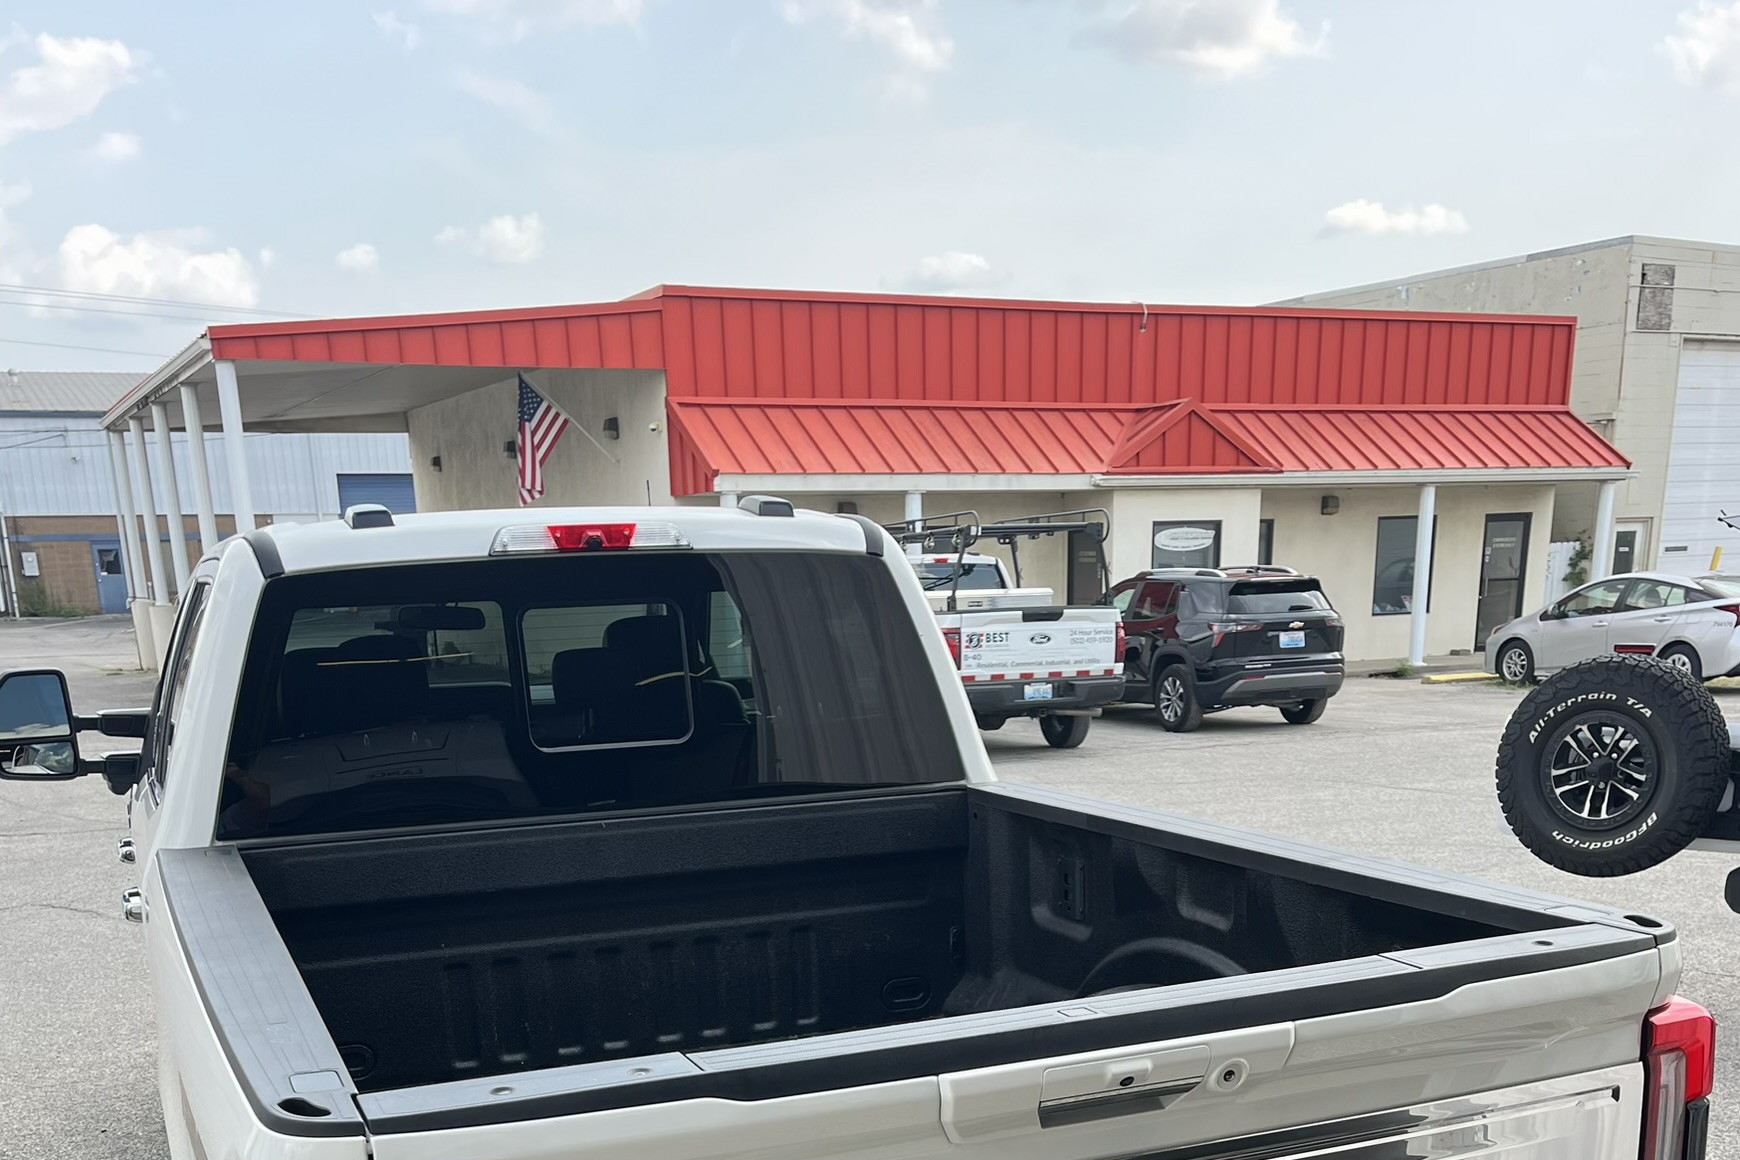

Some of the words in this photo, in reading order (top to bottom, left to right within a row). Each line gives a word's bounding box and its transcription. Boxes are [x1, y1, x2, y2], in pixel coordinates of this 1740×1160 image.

[985, 632, 1009, 643] BEST
[1528, 691, 1618, 744] All-Terrain
[1625, 696, 1653, 718] T/A
[1551, 811, 1659, 850] BFGoodrich
